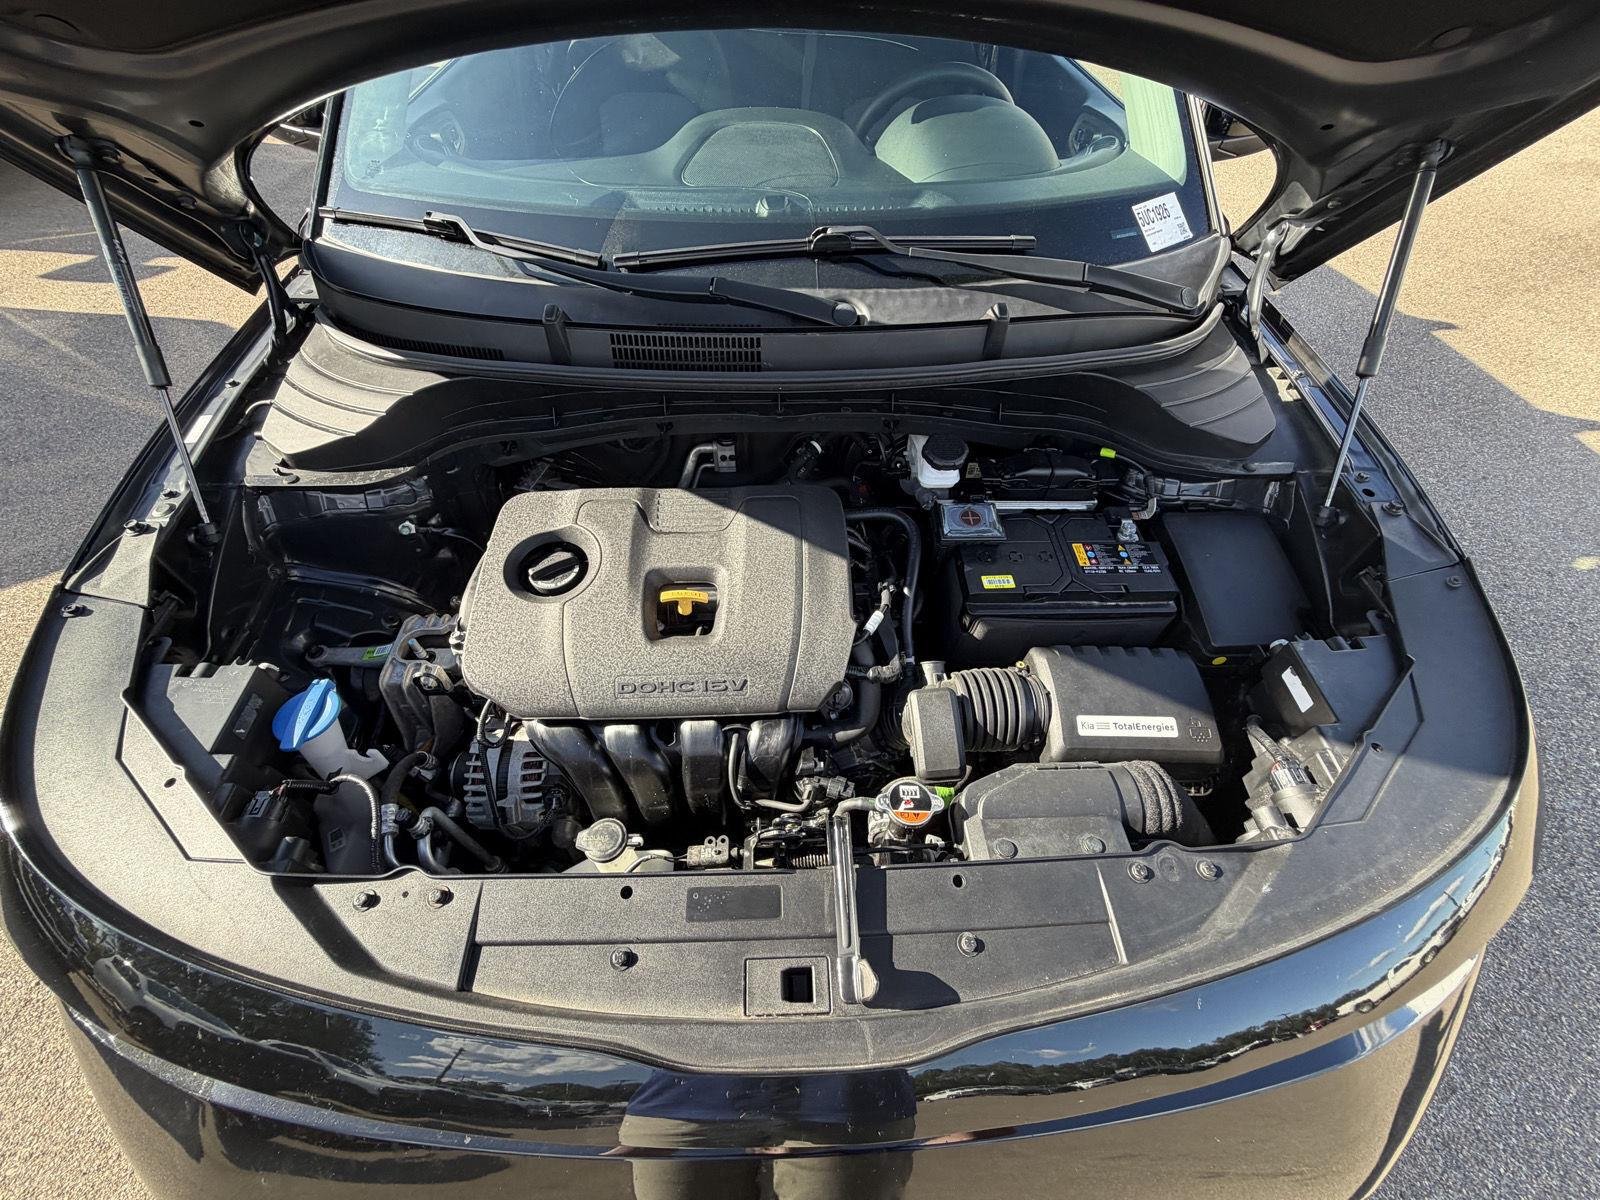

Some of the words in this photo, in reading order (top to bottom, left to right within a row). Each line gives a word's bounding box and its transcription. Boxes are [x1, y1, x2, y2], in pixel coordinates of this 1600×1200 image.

[1137, 203, 1170, 227] 5UC1926
[617, 680, 694, 694] DOHC
[1081, 721, 1095, 730] Kia
[1113, 722, 1175, 732] TotalEnergies
